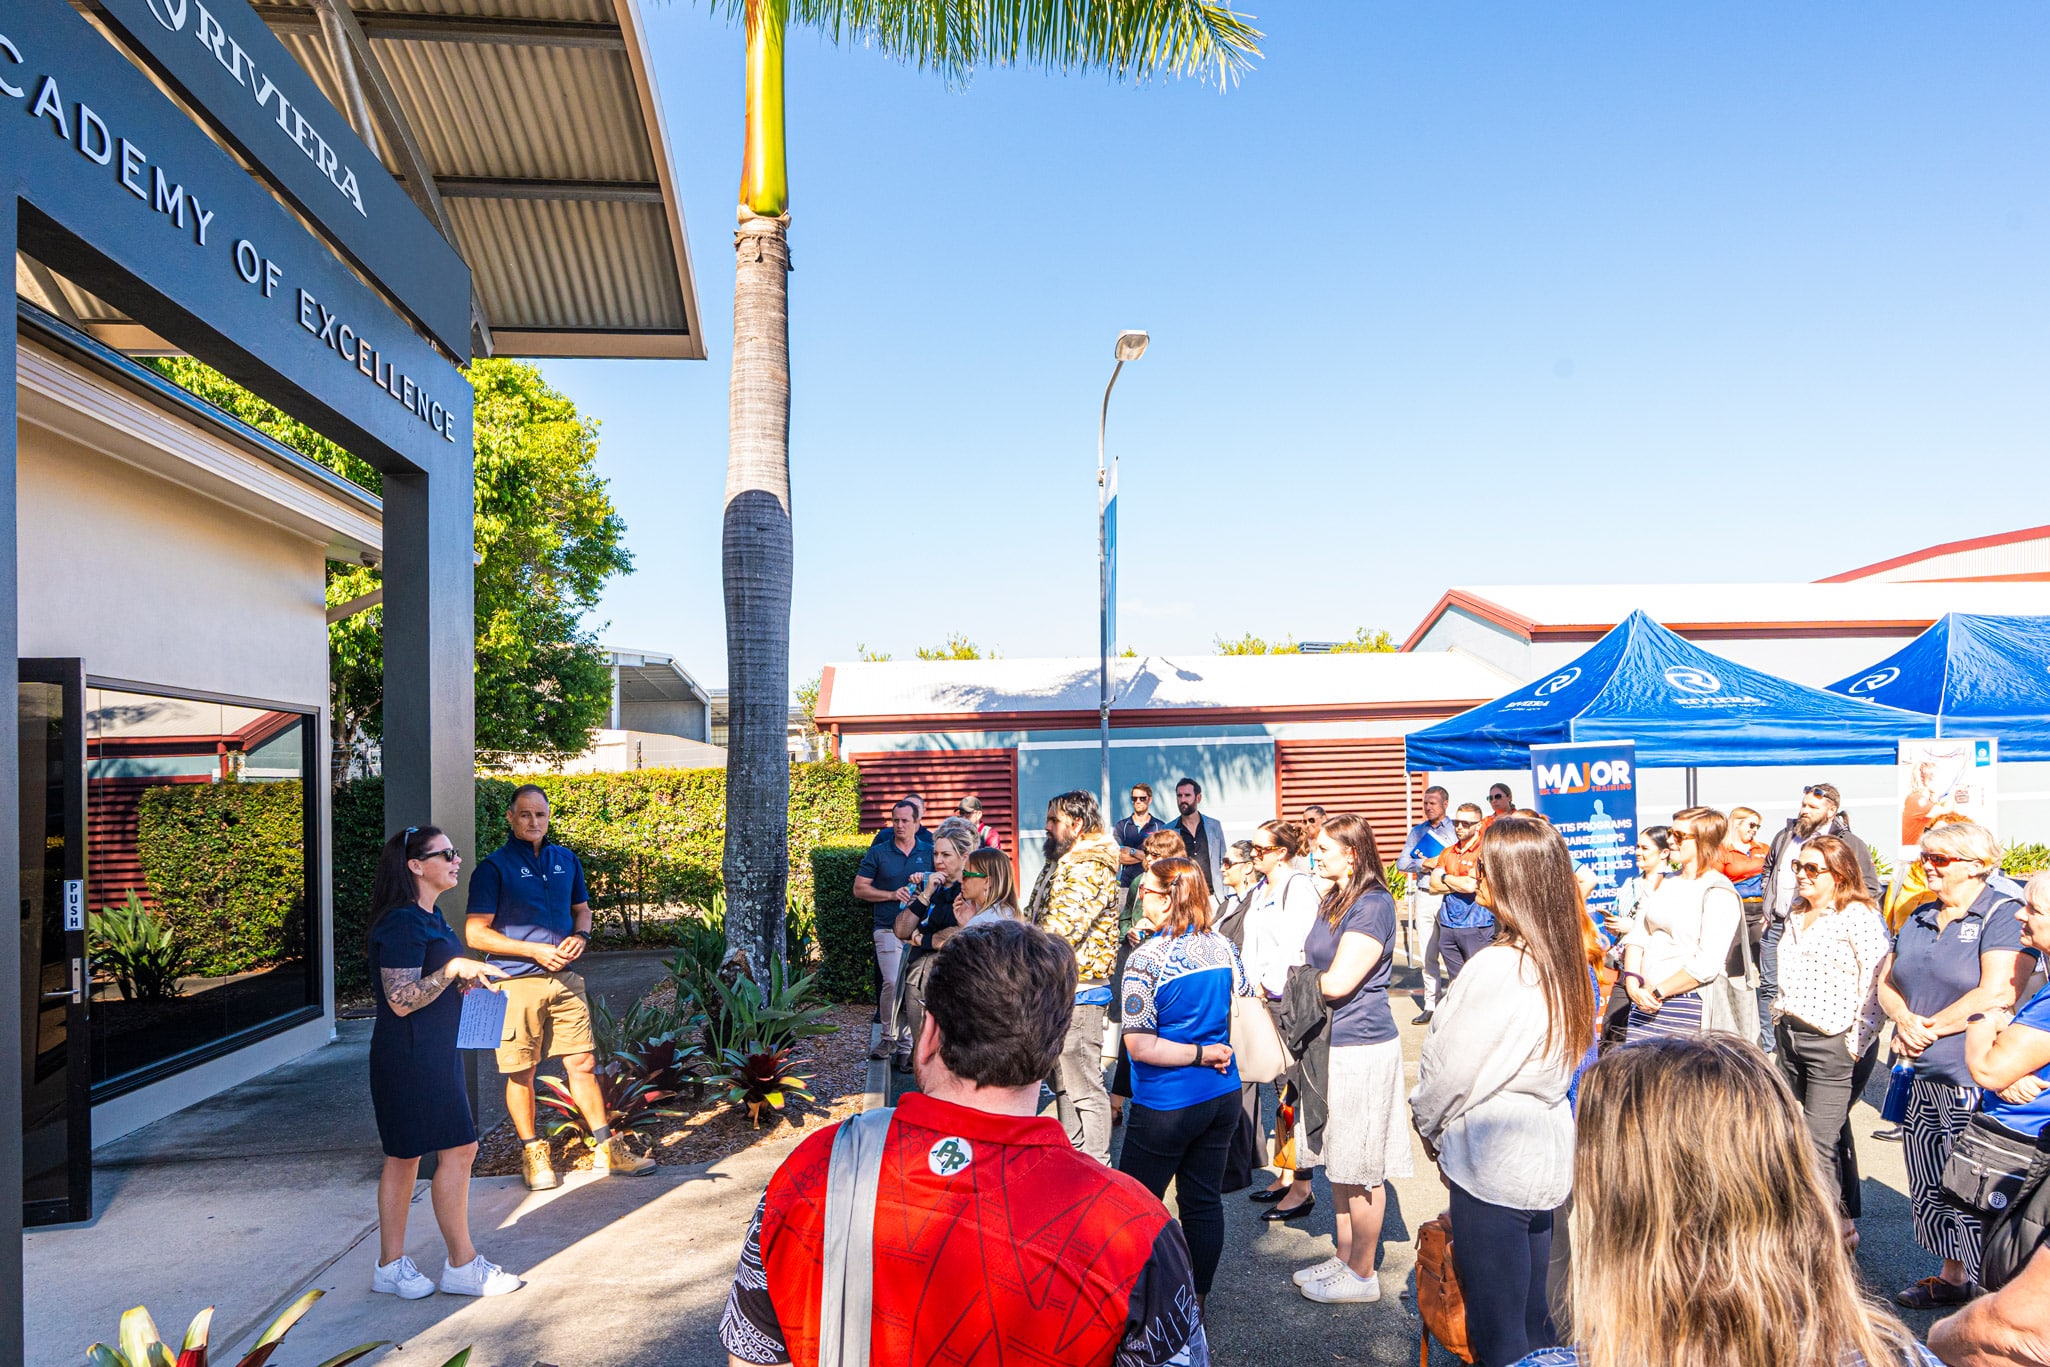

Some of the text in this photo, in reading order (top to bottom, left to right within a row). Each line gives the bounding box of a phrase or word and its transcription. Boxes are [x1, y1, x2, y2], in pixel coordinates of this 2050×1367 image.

[195, 0, 367, 218] RIVIERA
[0, 33, 456, 444] CADEMY OF EXCELLENCE
[1537, 760, 1632, 794] MAJOR
[1591, 783, 1632, 792] TRAINING
[1553, 819, 1633, 833] ETIS PROGRAMS
[1563, 833, 1626, 846] RAINEESHIPS
[1568, 846, 1636, 859] RENTICESHIPS
[1586, 887, 1619, 899] OURS
[70, 883, 78, 927] PUSH
